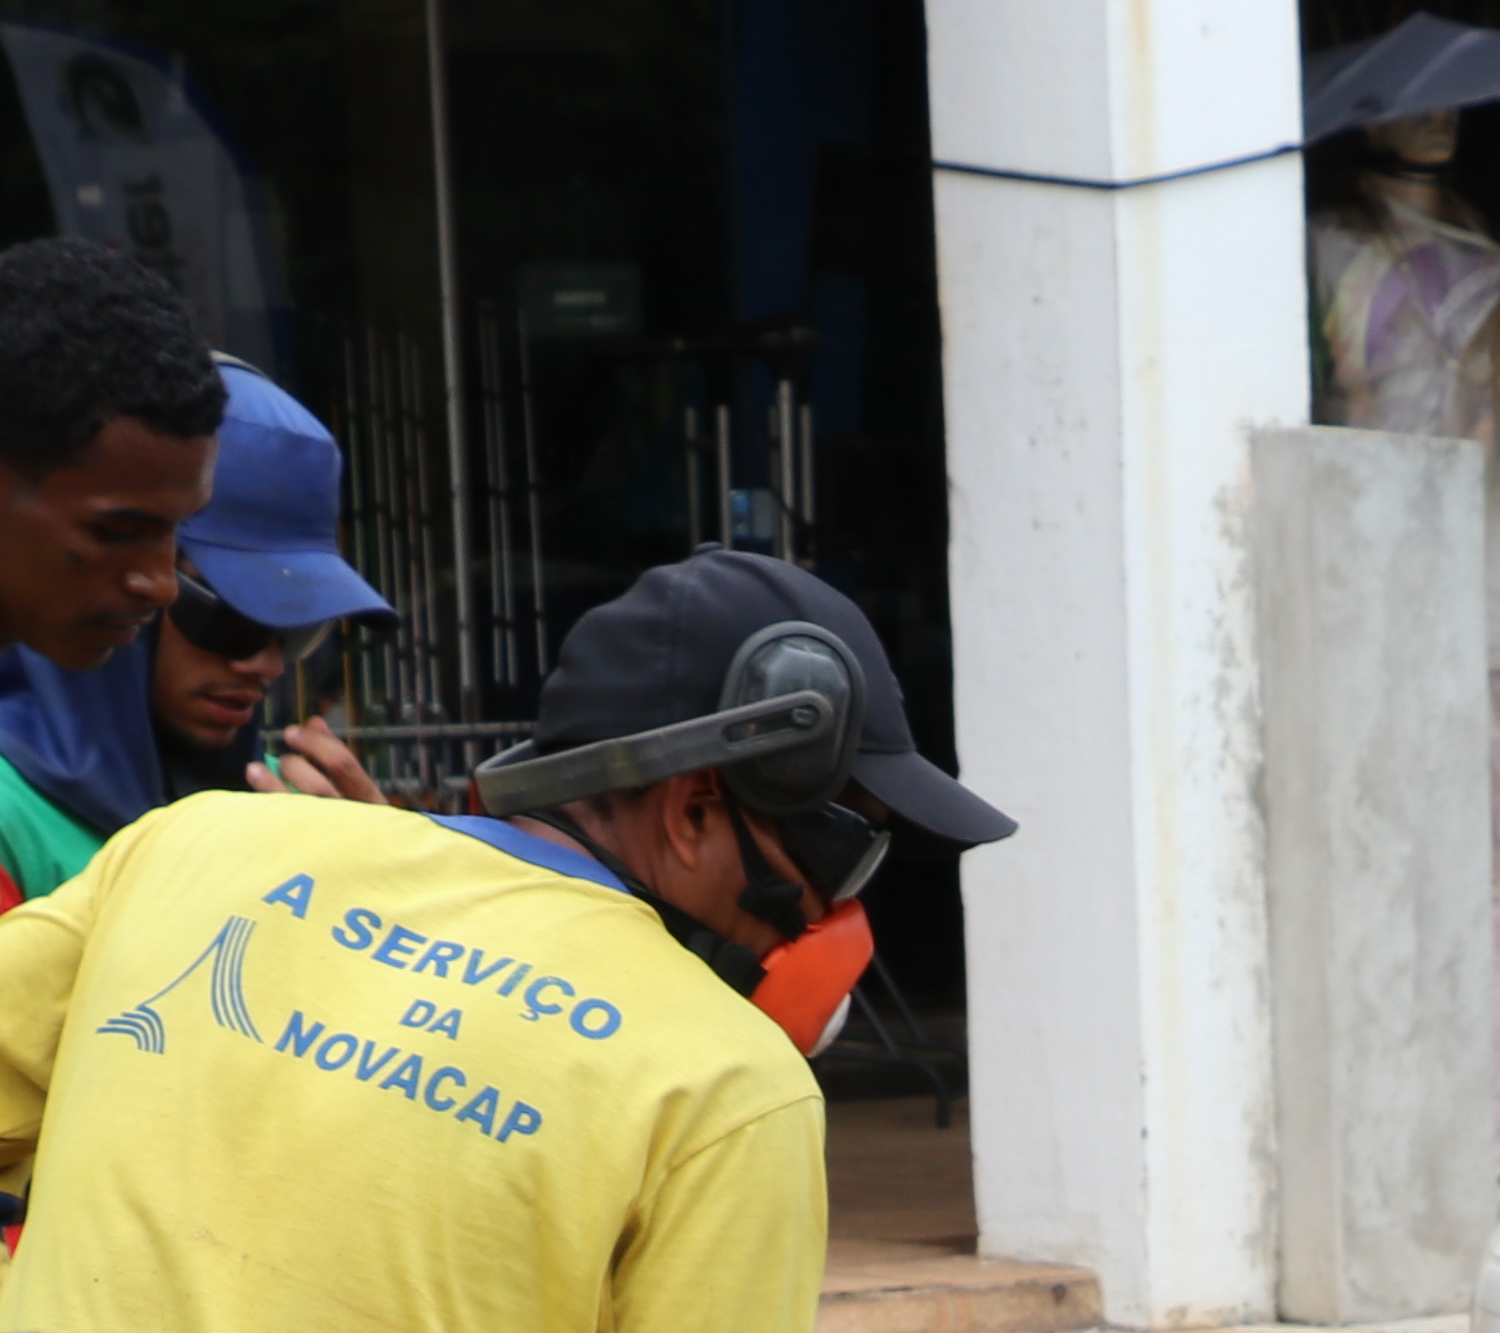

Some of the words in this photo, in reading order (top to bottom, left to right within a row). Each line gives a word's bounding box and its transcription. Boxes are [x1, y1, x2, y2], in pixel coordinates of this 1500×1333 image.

[262, 872, 317, 920] A
[331, 907, 623, 1041] SERVIÇO
[398, 998, 464, 1041] DA
[273, 1009, 543, 1144] NOVACAP
